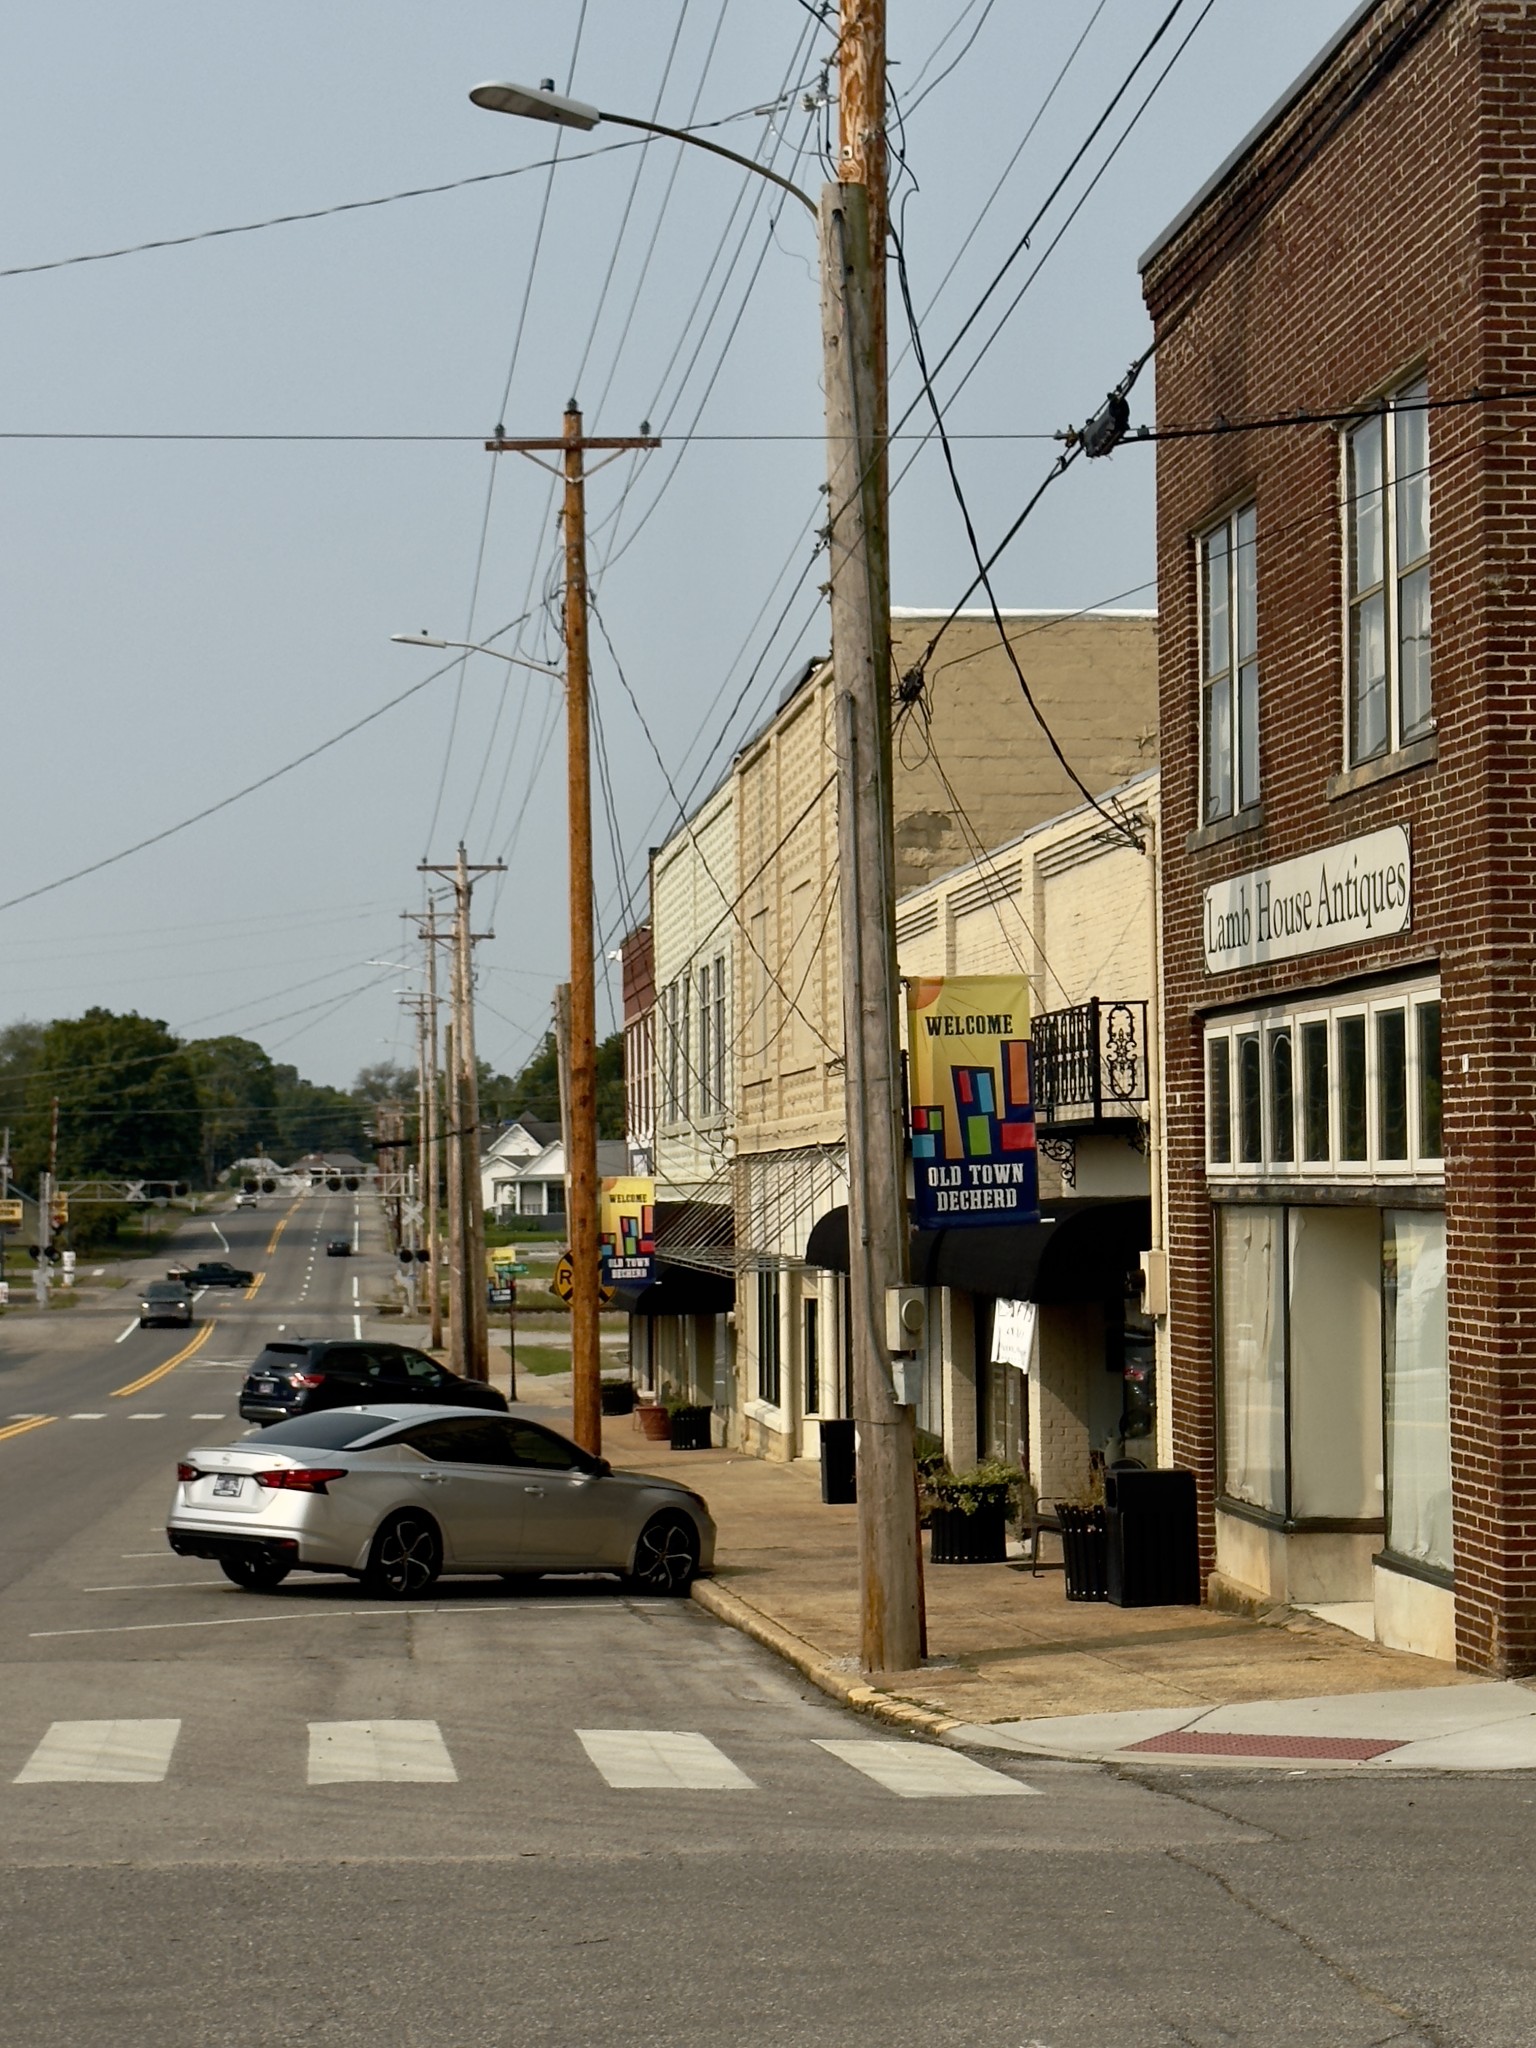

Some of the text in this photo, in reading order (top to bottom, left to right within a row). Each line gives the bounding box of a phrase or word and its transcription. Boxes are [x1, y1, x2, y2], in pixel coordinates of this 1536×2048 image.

[1207, 853, 1406, 954] Lamb House Antiques
[925, 1014, 1013, 1036] WELCOME
[928, 1162, 1024, 1187] OLD TOWN
[608, 1194, 648, 1204] WELCOME
[937, 1188, 1017, 1212] DECHERD
[559, 1269, 572, 1285] R
